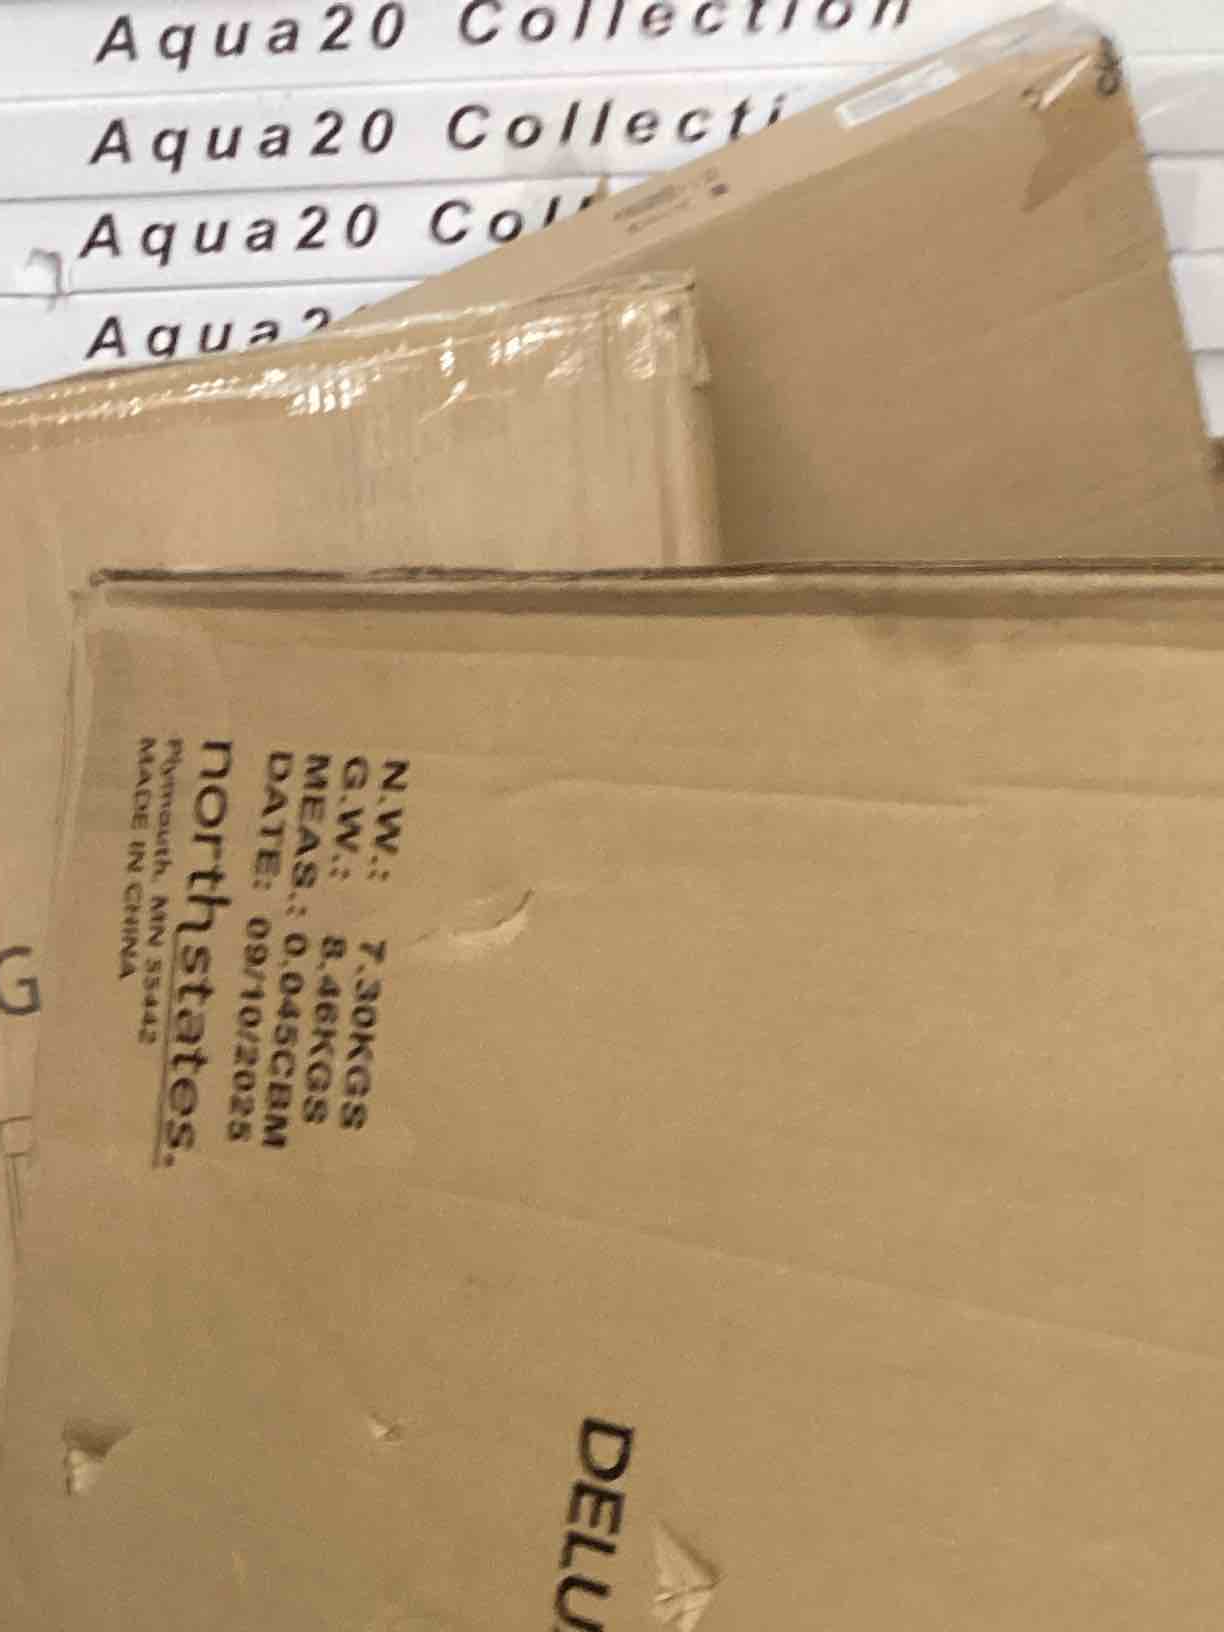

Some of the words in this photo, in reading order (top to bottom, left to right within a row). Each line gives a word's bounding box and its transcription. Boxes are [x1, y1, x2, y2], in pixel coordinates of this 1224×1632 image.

[94, 2, 405, 72] Aqua20
[88, 108, 394, 174] Aqua20
[446, 93, 788, 151] Collecti
[78, 203, 378, 267] Aqua20
[130, 737, 156, 832] MADE
[253, 752, 293, 891] DATE:
[126, 841, 146, 874] IN
[119, 881, 144, 981] CHINA
[147, 895, 168, 949] MN
[338, 940, 386, 1130] 7.30KGS
